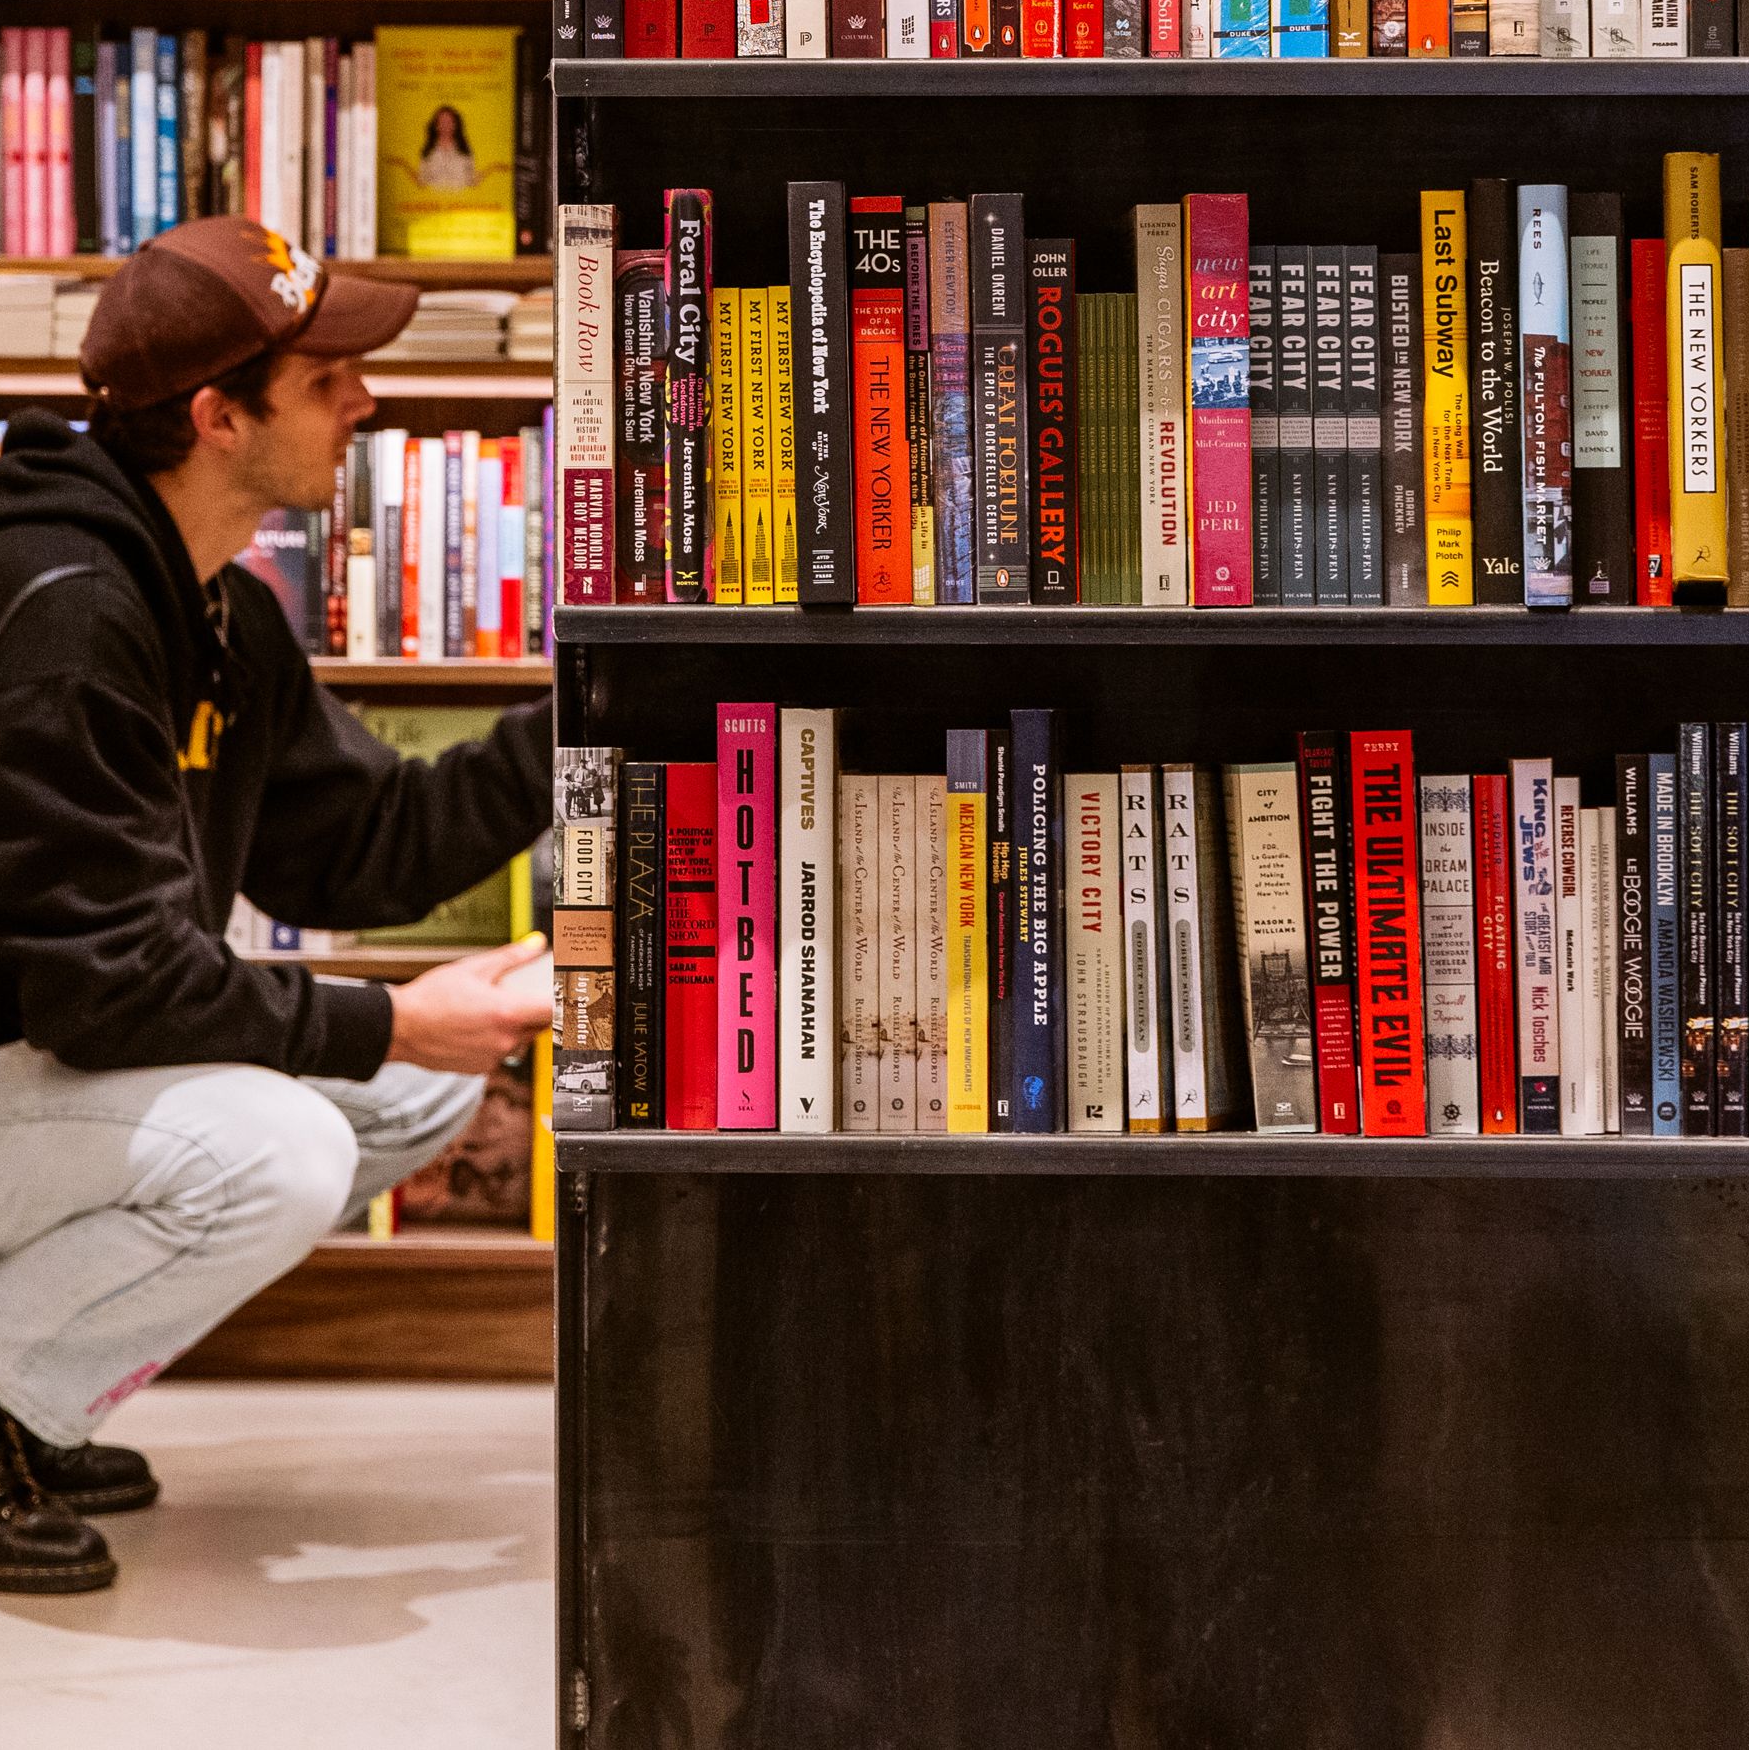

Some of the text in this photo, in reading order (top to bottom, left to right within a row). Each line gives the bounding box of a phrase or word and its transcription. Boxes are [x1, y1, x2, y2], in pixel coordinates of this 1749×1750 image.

[855, 230, 900, 249] THE
[1033, 253, 1066, 264] JOHN
[1032, 268, 1067, 277] OLLER
[675, 219, 701, 364] Feral City
[1202, 284, 1237, 300] art
[1433, 209, 1458, 378] Last Subway
[1197, 305, 1245, 333] city
[1689, 282, 1708, 478] THE NEW YORKERS
[683, 438, 694, 554] Jeremiah Moss
[1038, 428, 1066, 564] GALLERY
[1207, 500, 1237, 513] JED
[1200, 519, 1244, 531] PERL
[1436, 528, 1462, 538] Philip
[1439, 540, 1460, 548] Mark
[1436, 551, 1463, 560] Plotch
[1484, 558, 1520, 576] Yale
[724, 720, 766, 733] SCUTTS
[1364, 743, 1399, 752] TERRY
[801, 729, 815, 830] CAPTIVES
[954, 781, 977, 789] SMITH
[1425, 823, 1465, 836] INSIDE
[1126, 795, 1147, 904] RATS
[1167, 795, 1189, 904] RATS
[1425, 860, 1467, 873] DREAM
[1423, 879, 1469, 893] PALACE
[736, 750, 755, 1074] HOTBED
[1364, 763, 1411, 1086] THE ULTIMATE EVIL
[801, 862, 815, 1059] JARROD SHANAHAN
